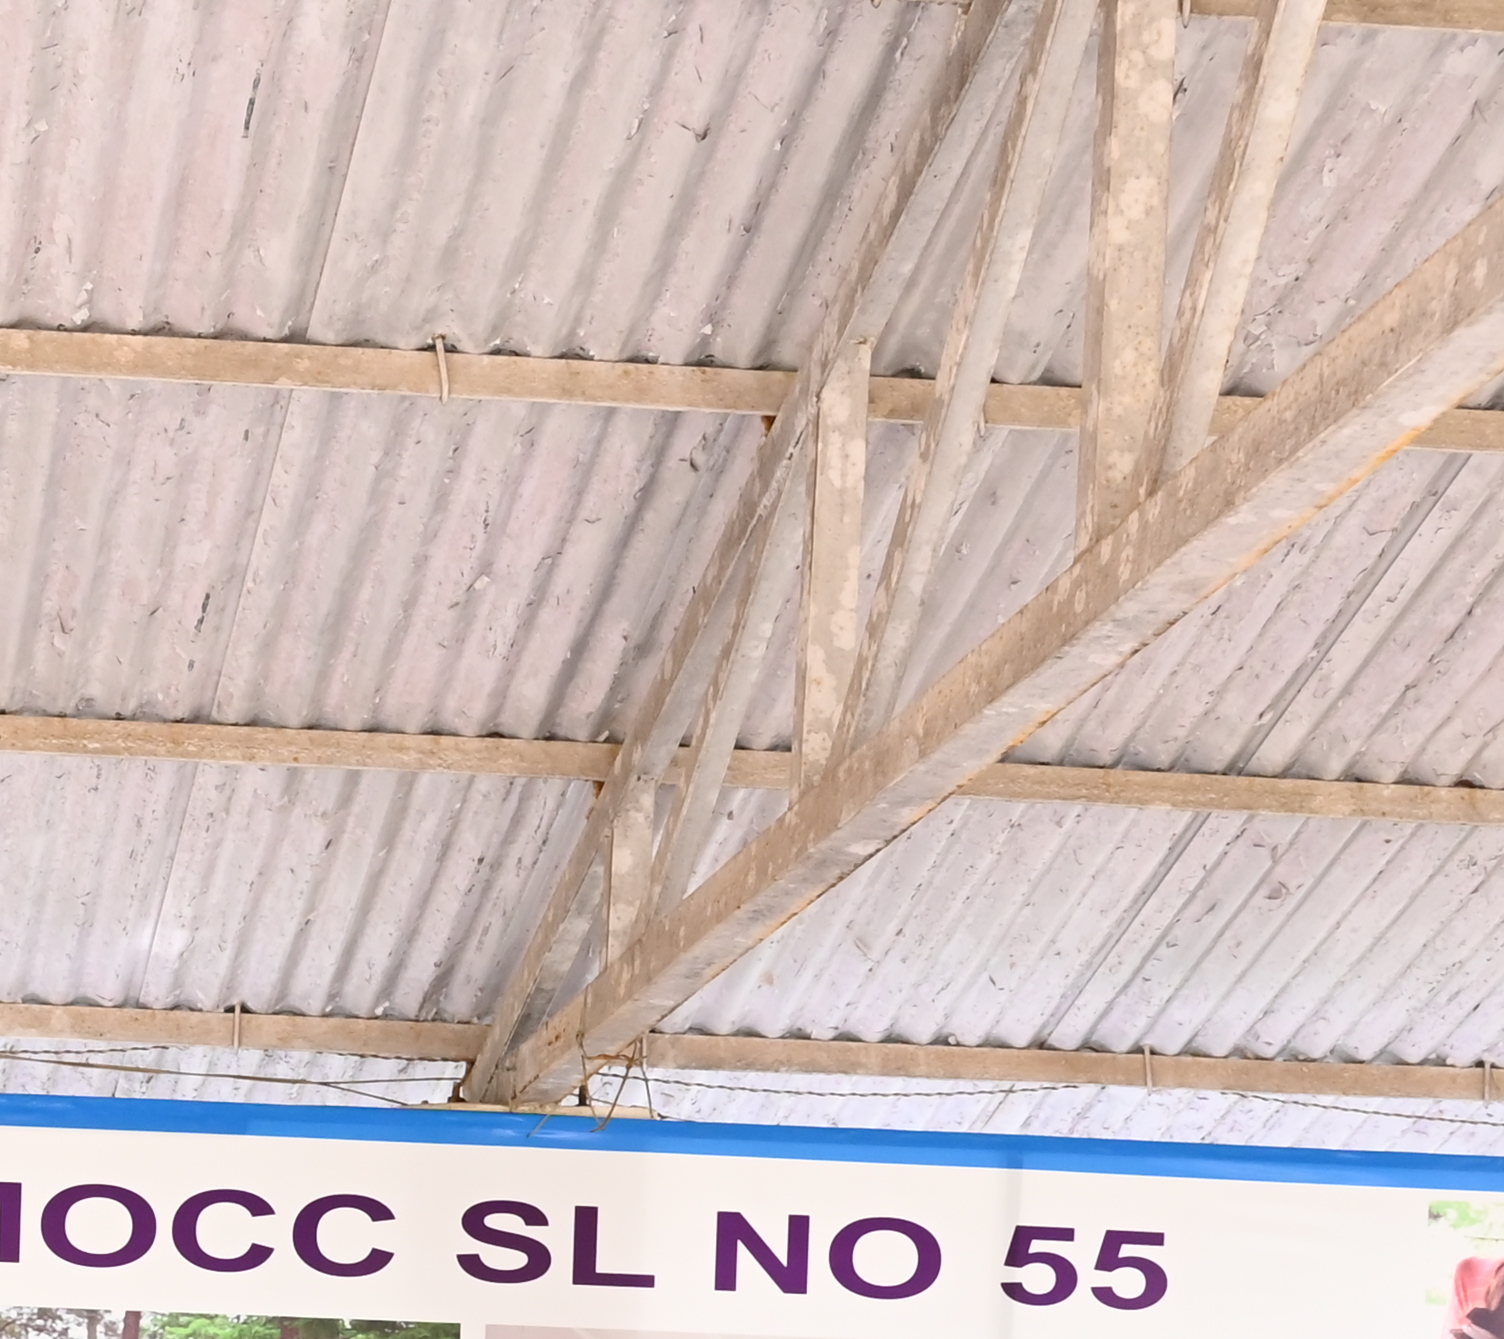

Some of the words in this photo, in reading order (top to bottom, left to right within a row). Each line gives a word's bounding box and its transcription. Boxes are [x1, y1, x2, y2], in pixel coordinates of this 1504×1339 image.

[458, 1200, 655, 1288] SL
[714, 1211, 943, 1300] NO
[1003, 1225, 1169, 1310] 55
